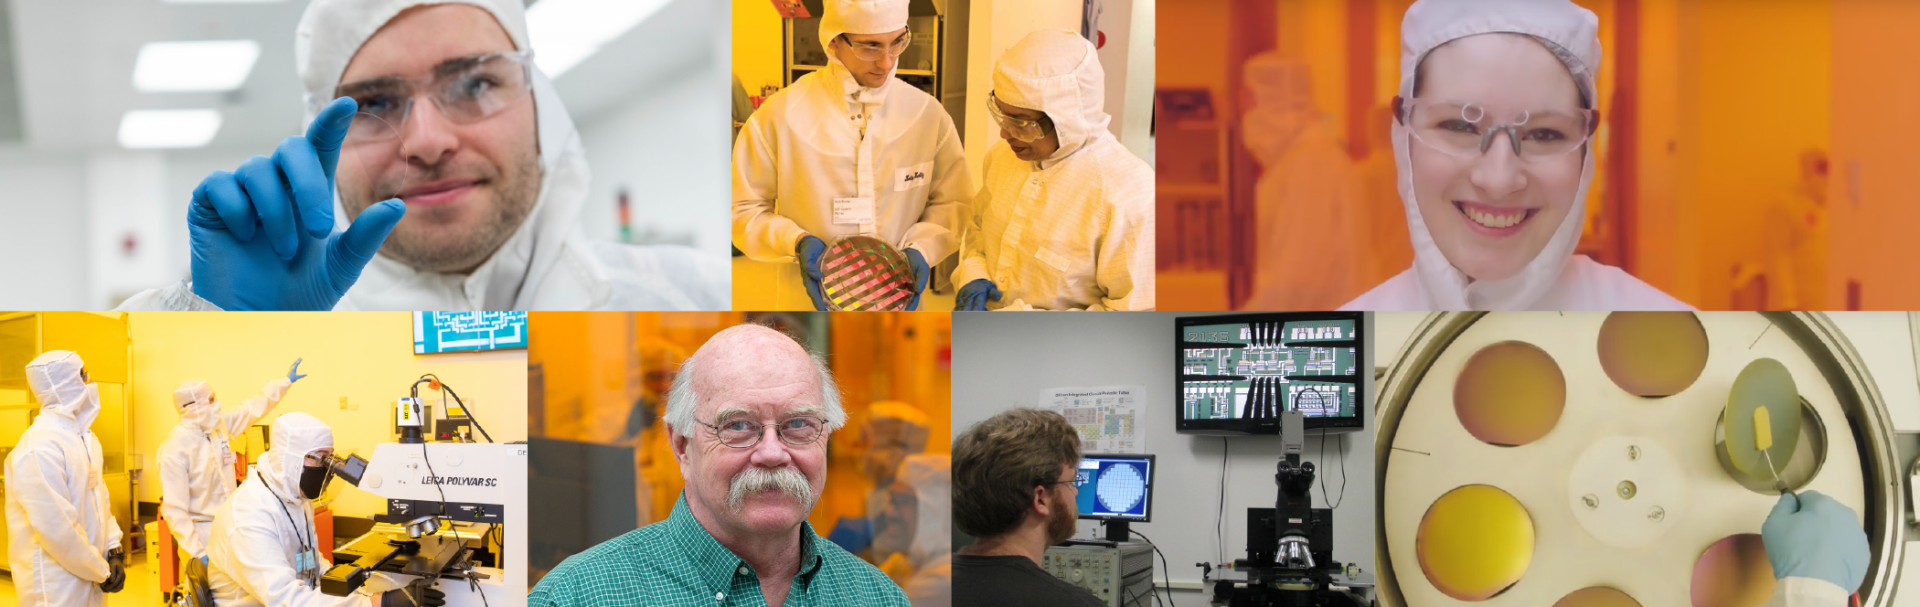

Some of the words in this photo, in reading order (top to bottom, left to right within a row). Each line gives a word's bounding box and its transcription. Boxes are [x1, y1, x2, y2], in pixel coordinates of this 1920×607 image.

[1187, 331, 1229, 342] 2135
[421, 476, 444, 485] LEICA
[446, 476, 483, 486] POLYVAR
[485, 478, 497, 487] SC
